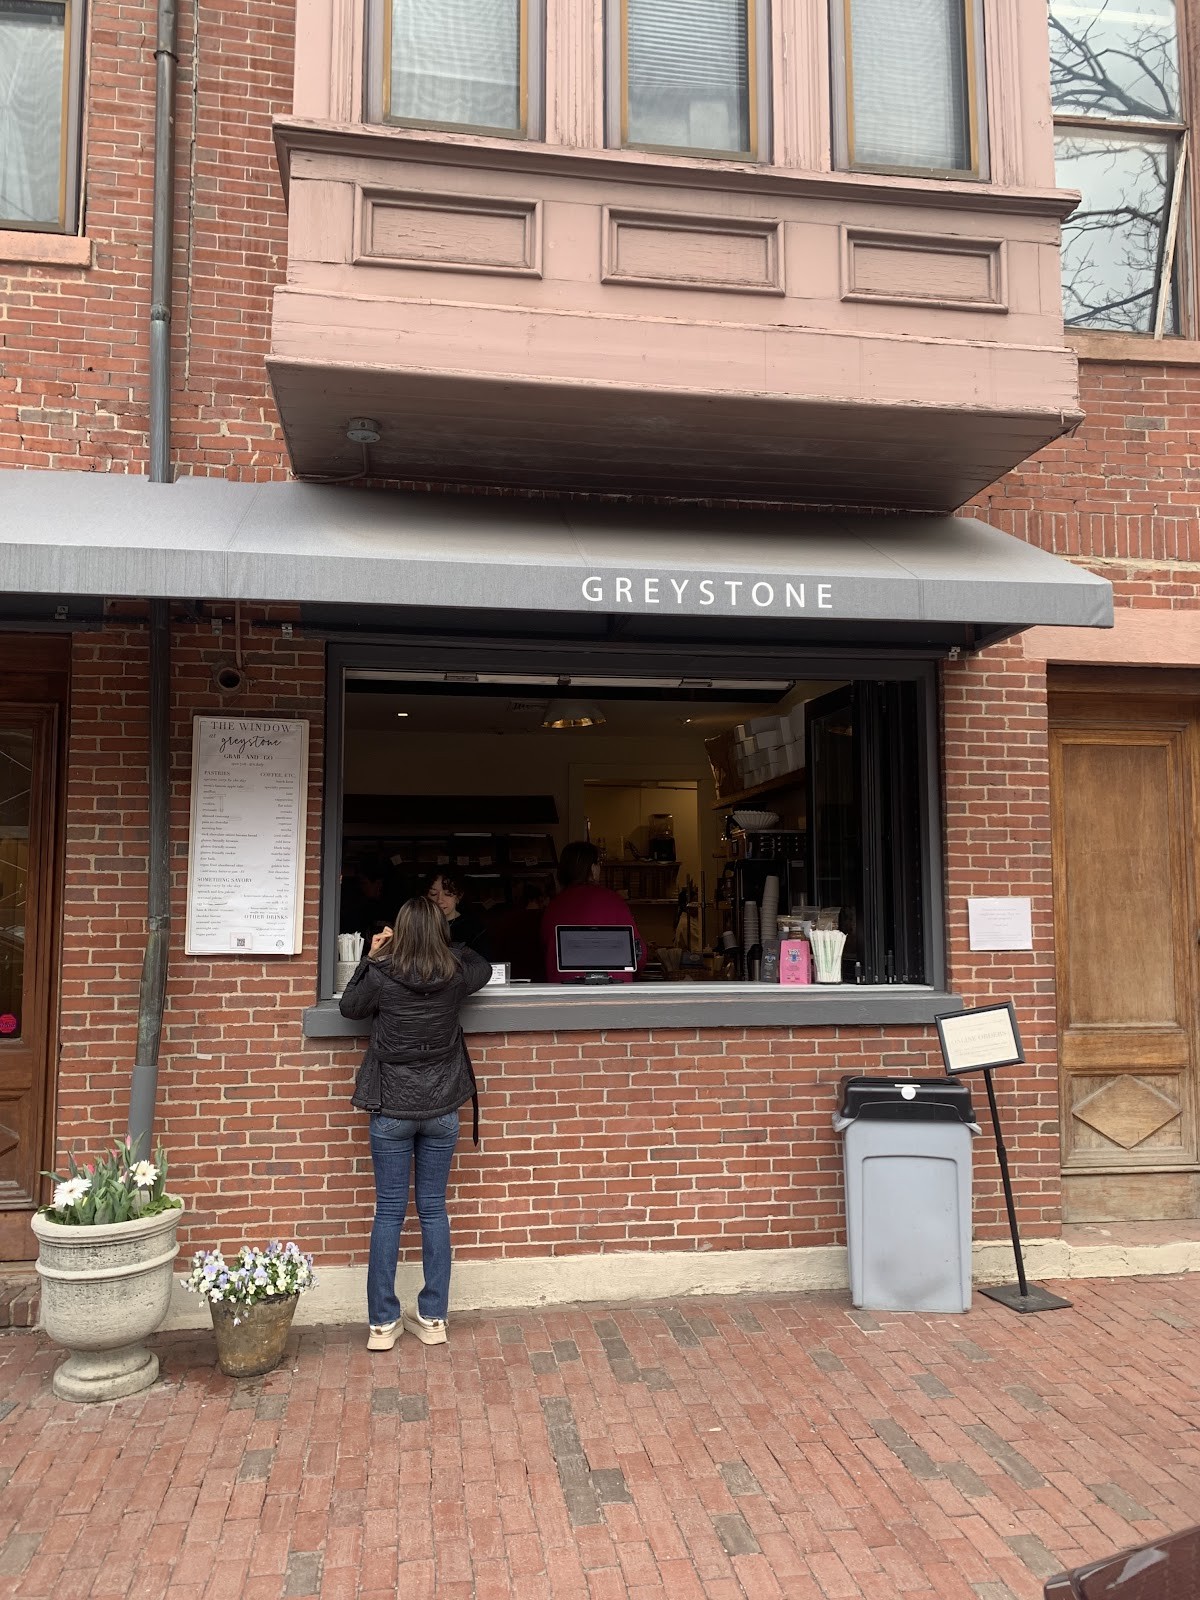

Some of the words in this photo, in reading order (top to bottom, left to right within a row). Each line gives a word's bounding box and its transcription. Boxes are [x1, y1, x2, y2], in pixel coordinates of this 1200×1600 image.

[581, 577, 833, 608] GREYSTONE
[211, 721, 235, 730] THE
[239, 722, 291, 733] WINDOW
[219, 735, 282, 753] greystone
[950, 1035, 977, 1045] ONLINE
[977, 1031, 1007, 1040] ORDERS
